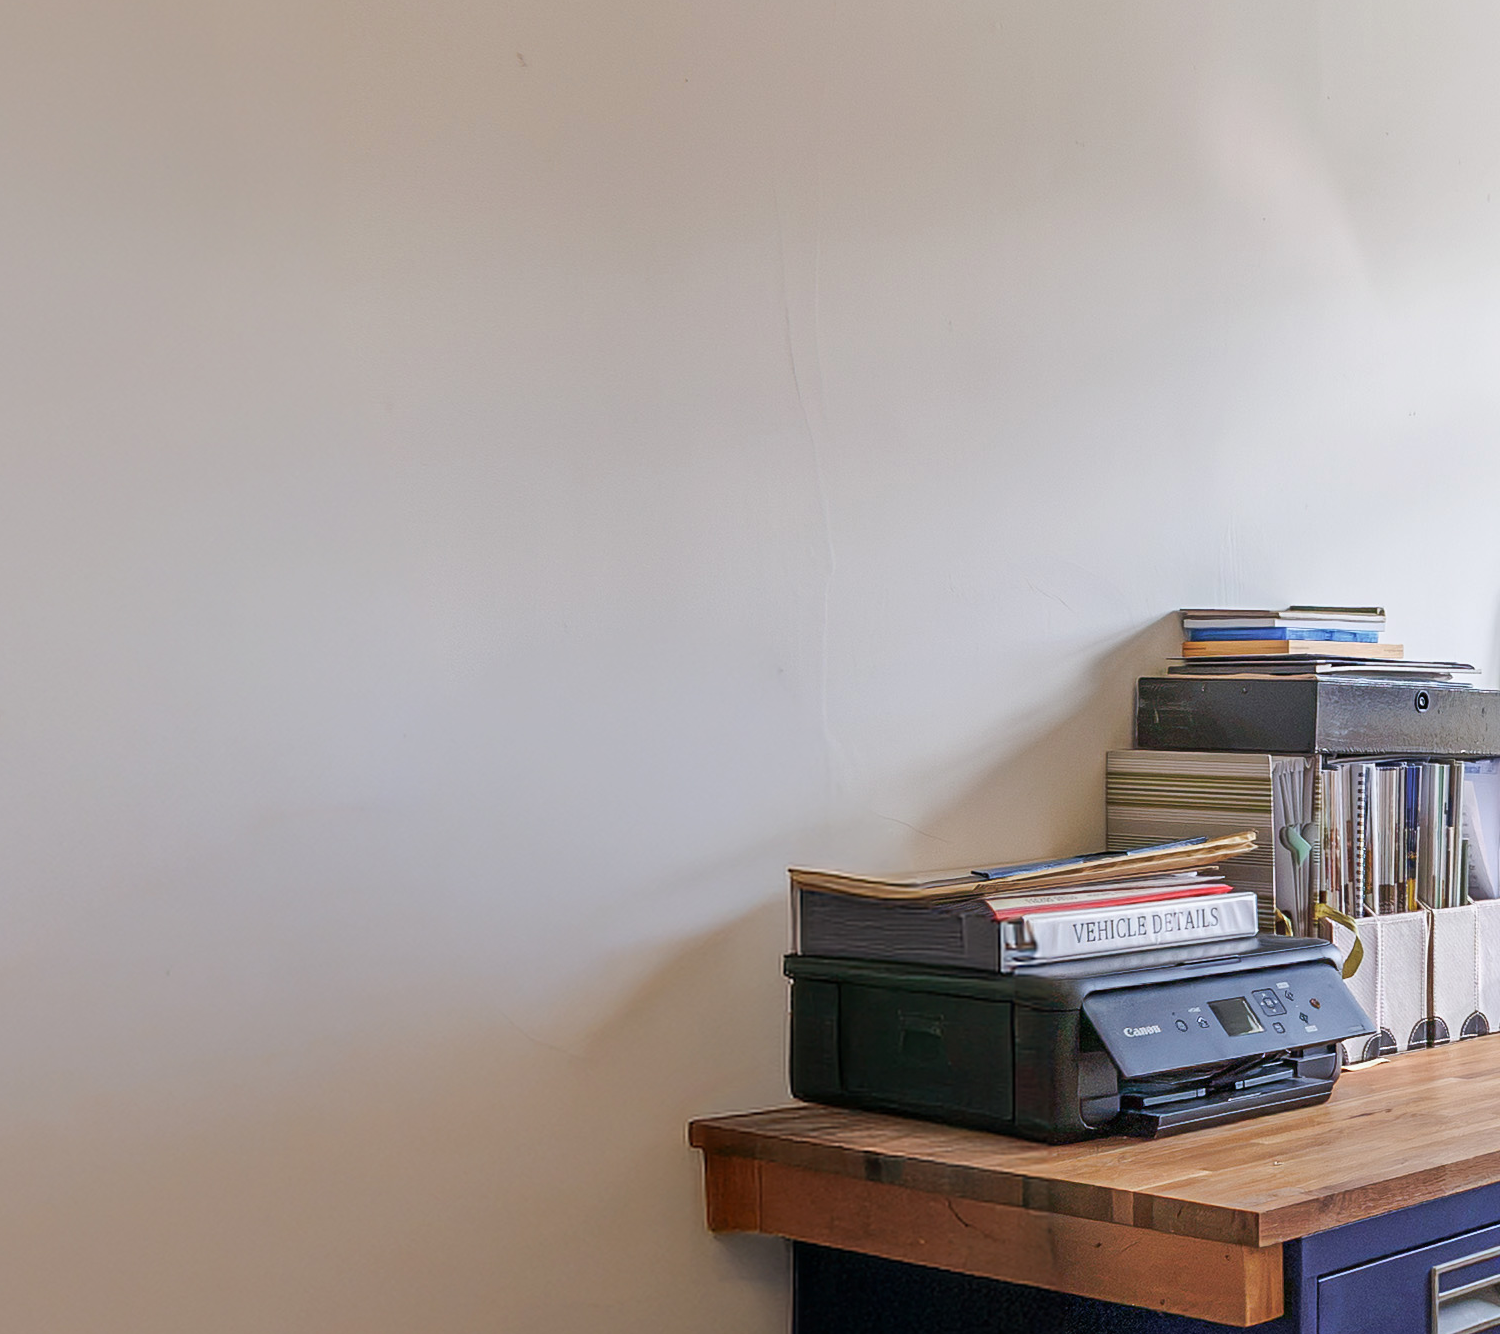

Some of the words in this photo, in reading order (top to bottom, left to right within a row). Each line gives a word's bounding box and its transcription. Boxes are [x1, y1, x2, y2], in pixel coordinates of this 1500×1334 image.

[1073, 916, 1147, 943] VEHICLE
[1153, 907, 1219, 935] DETAILS
[1123, 1023, 1161, 1038] Canon
